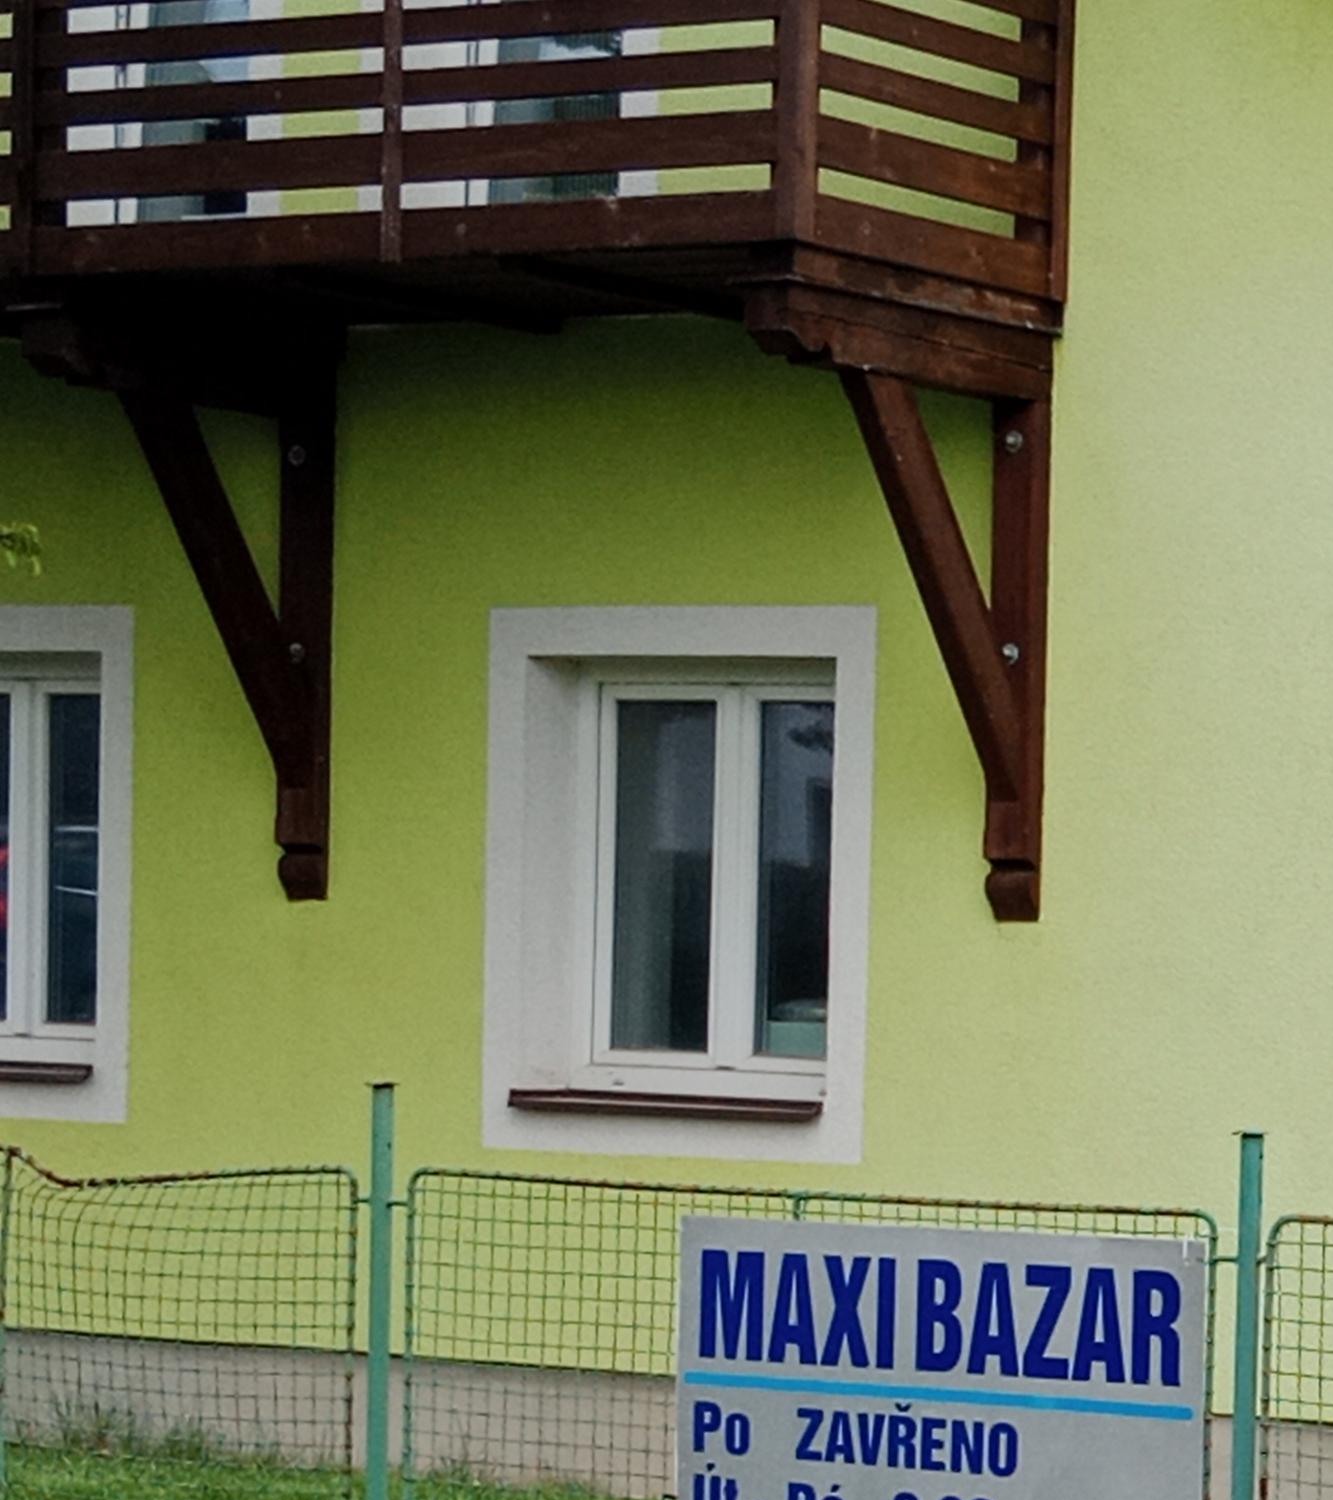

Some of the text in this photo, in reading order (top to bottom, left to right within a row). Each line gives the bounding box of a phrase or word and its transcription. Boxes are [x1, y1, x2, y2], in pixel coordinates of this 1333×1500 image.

[698, 1249, 1181, 1387] MAXI BAZAR
[692, 1400, 1019, 1478] Po ZAVŘENO
